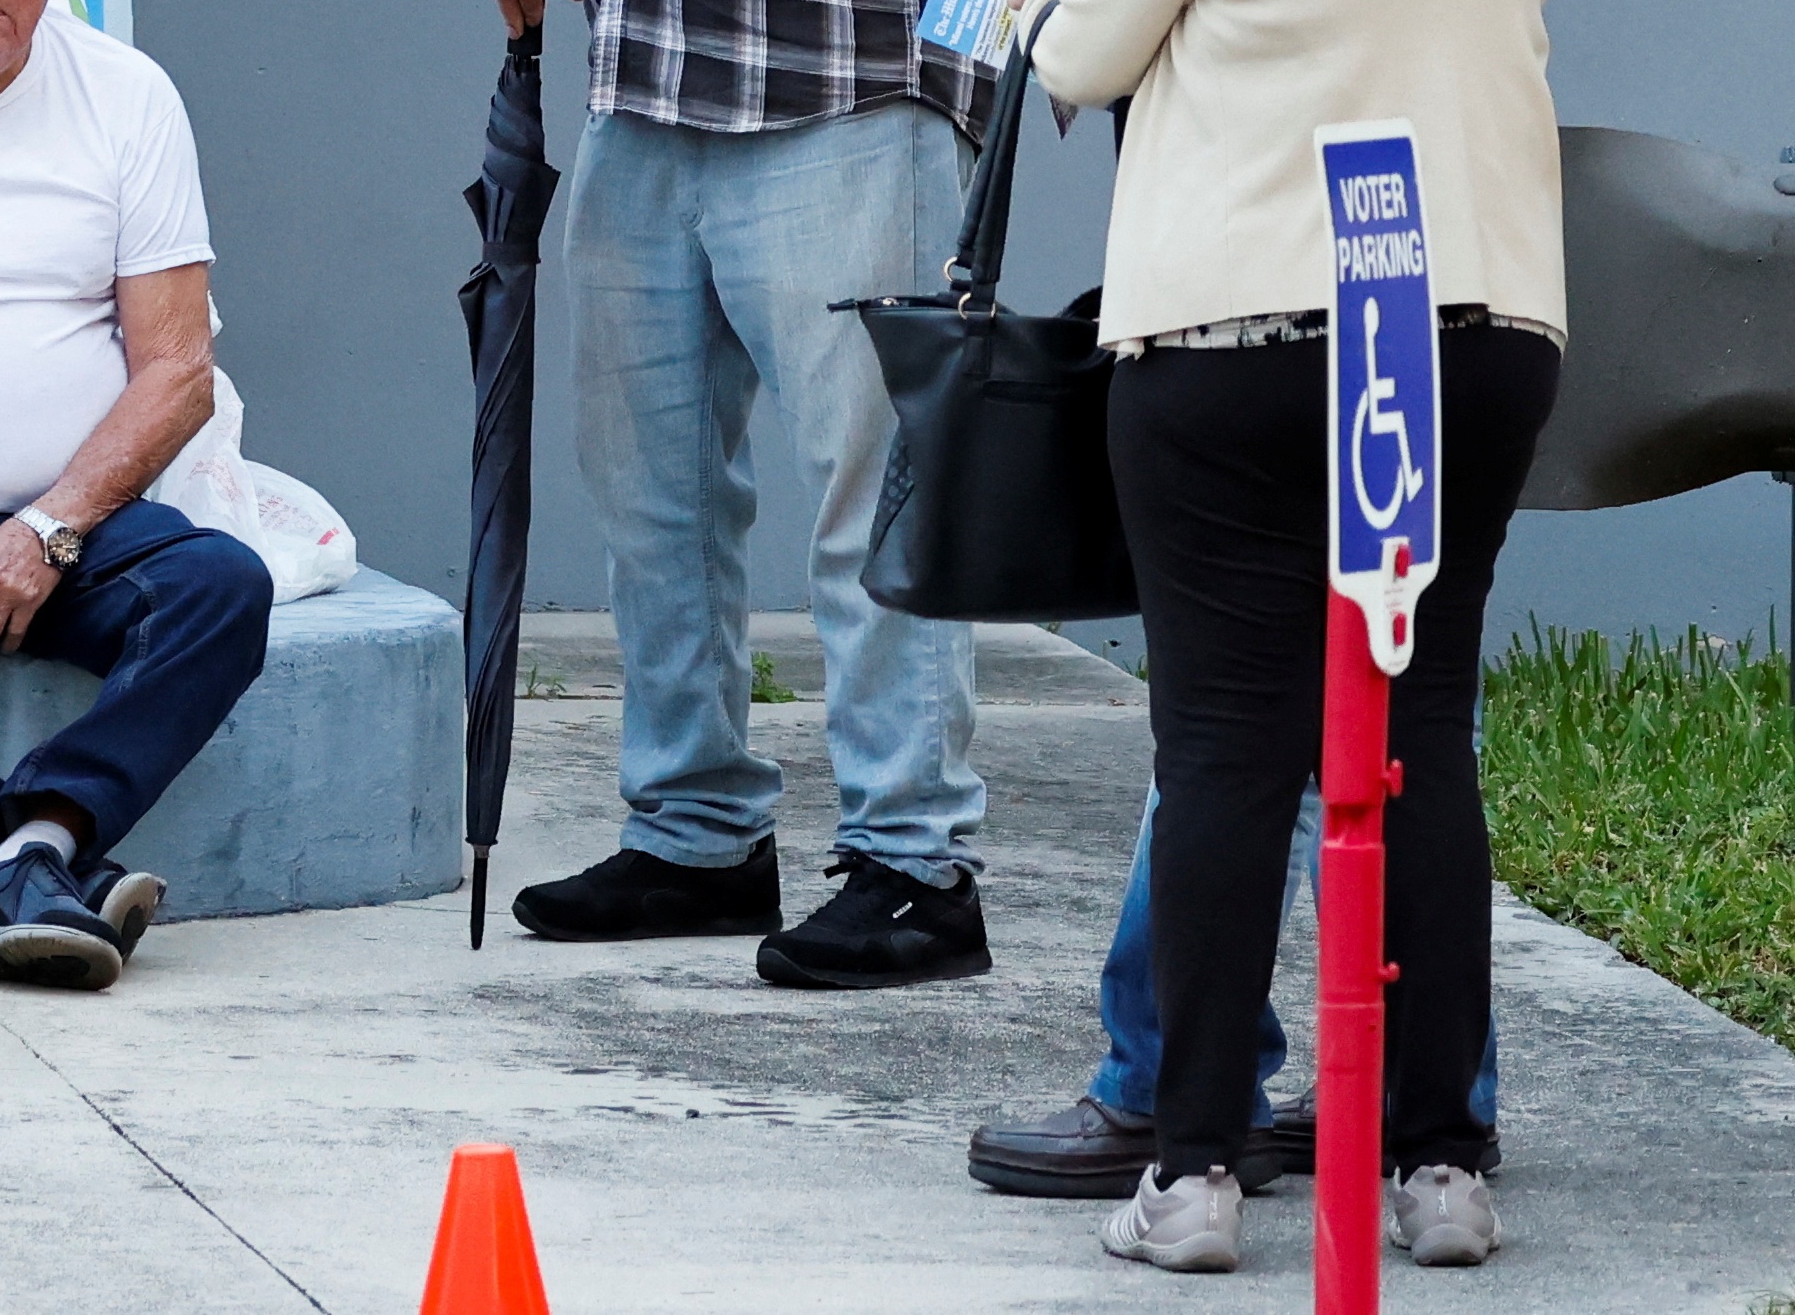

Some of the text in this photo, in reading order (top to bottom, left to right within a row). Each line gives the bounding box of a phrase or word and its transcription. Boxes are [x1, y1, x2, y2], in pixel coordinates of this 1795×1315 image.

[934, 16, 950, 37] The
[1339, 173, 1408, 223] VOTER
[1337, 229, 1424, 283] PARKING
